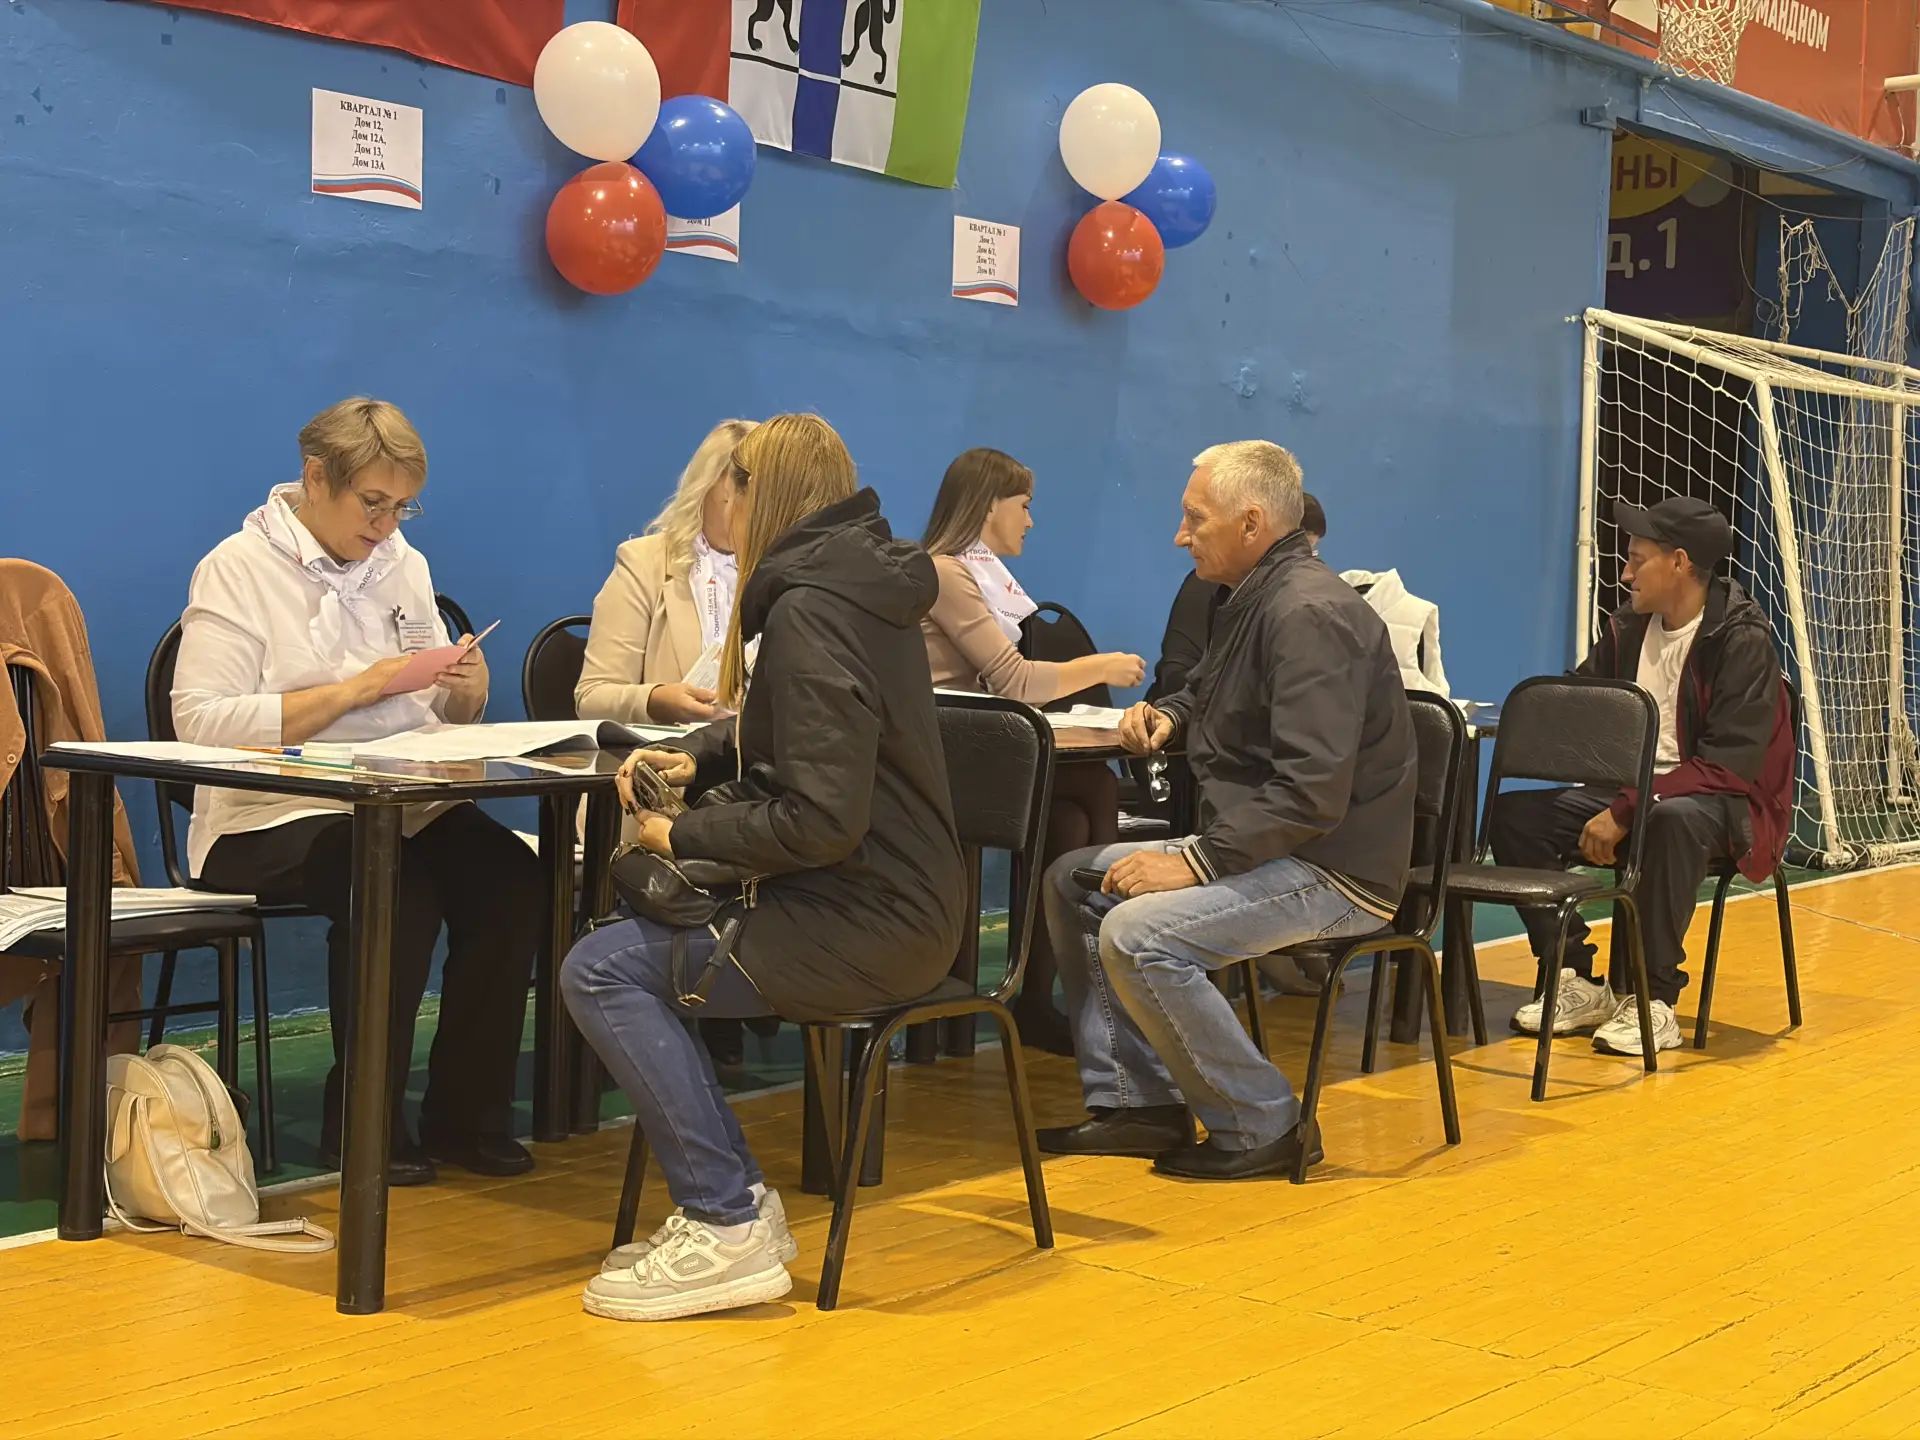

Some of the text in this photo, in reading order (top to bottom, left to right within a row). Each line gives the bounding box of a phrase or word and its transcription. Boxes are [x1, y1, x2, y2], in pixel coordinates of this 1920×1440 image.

[1747, 0, 1830, 52] МАНДНОМ
[340, 100, 380, 118] КВАРТАЛ
[384, 110, 392, 118] №
[354, 118, 384, 132] Дом 12,
[352, 130, 386, 144] Дом 12А,
[354, 144, 384, 158] Дом 13,
[352, 156, 384, 170] Дом 13А
[1611, 153, 1678, 191] НЫ
[970, 223, 996, 234] КВАРТАЛ
